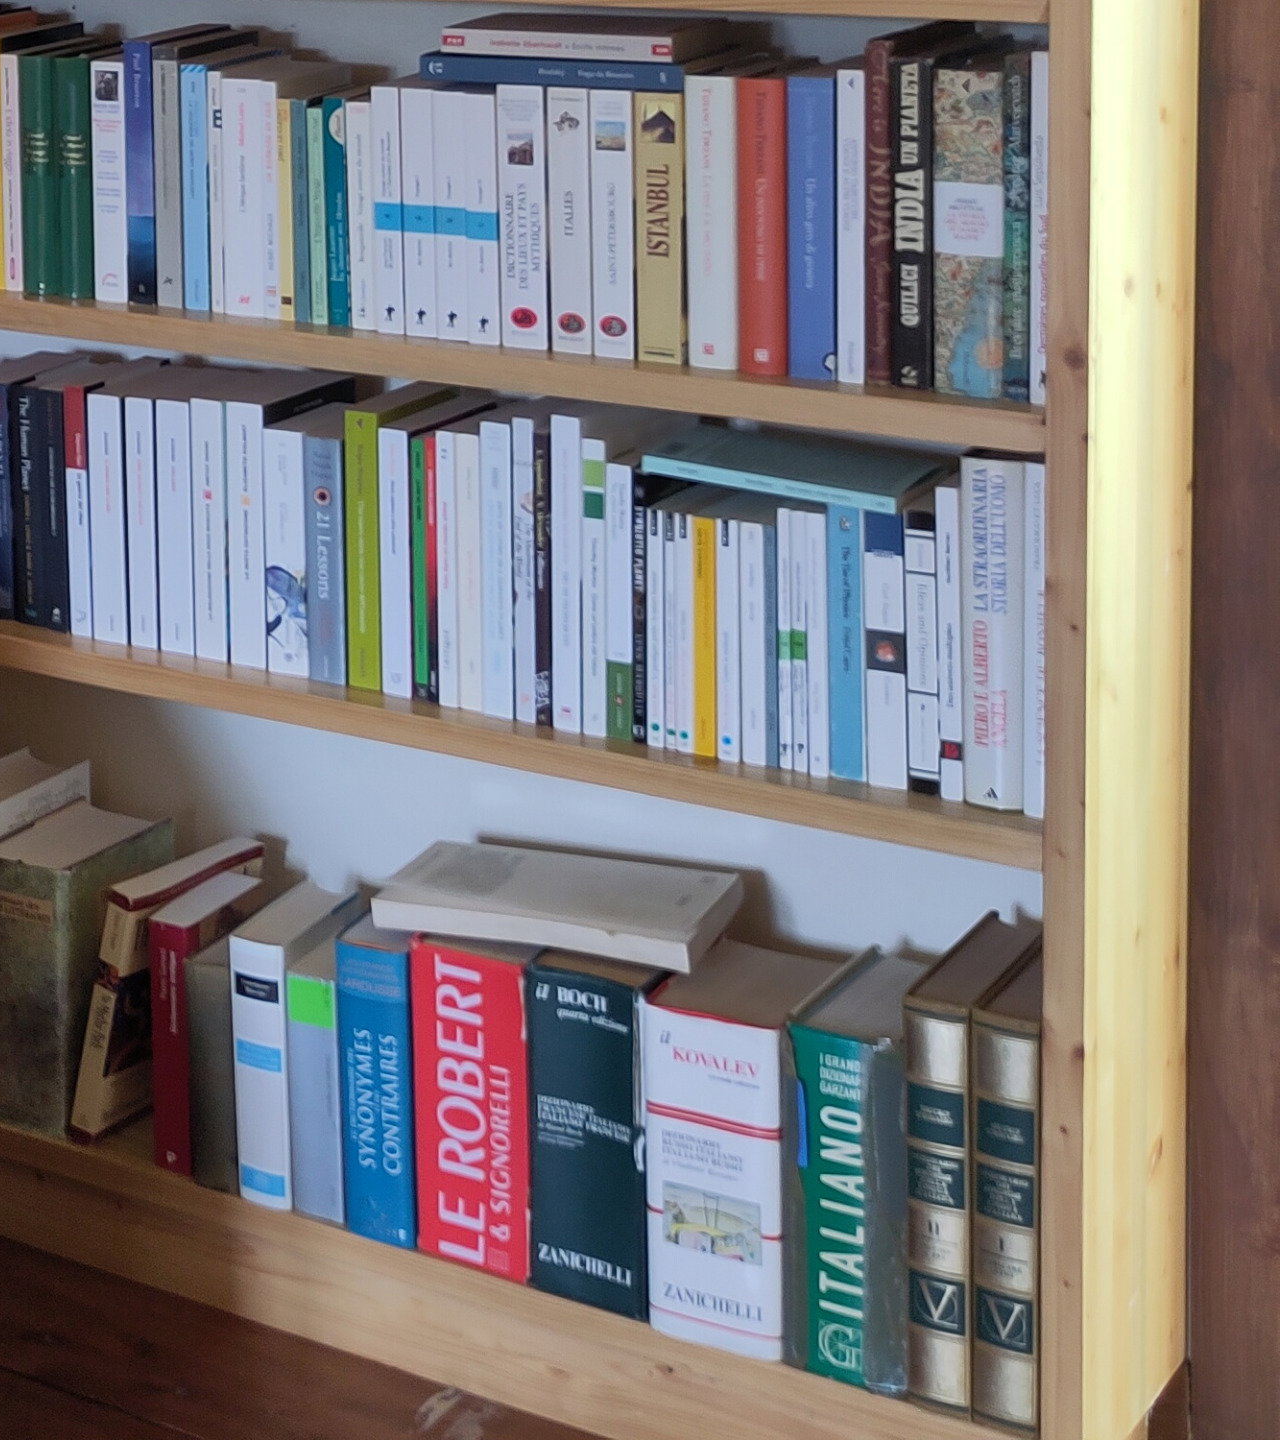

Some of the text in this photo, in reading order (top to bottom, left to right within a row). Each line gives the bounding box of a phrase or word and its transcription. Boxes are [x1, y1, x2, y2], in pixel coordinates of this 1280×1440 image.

[504, 193, 516, 280] DICTIONNAIRE
[517, 183, 528, 215] PAYS
[562, 190, 574, 237] ITALIES
[646, 163, 671, 259] ISTANBUL
[893, 63, 925, 328] QUILICI INDIA UN PIANETA
[19, 396, 31, 491] The Human Planet
[315, 511, 331, 600] 21 Lessons
[972, 468, 988, 591] STRAORDINARIA
[972, 593, 988, 612] LA
[991, 561, 1007, 615] STORIA
[972, 619, 988, 687] ALBERTO
[535, 981, 608, 1013] il BOCH
[659, 1029, 672, 1046] il
[353, 1027, 377, 1170] SYNONYMES
[671, 1045, 759, 1078] KOVALEV
[378, 1033, 404, 1178] CONTRAIRES
[433, 951, 488, 1266] LE ROBERT
[489, 1063, 512, 1243] & SIGNORELLI
[818, 1104, 865, 1321] ITALIANO
[537, 1242, 632, 1288] ZANICHELLI
[662, 1281, 763, 1322] ZANICHELLI
